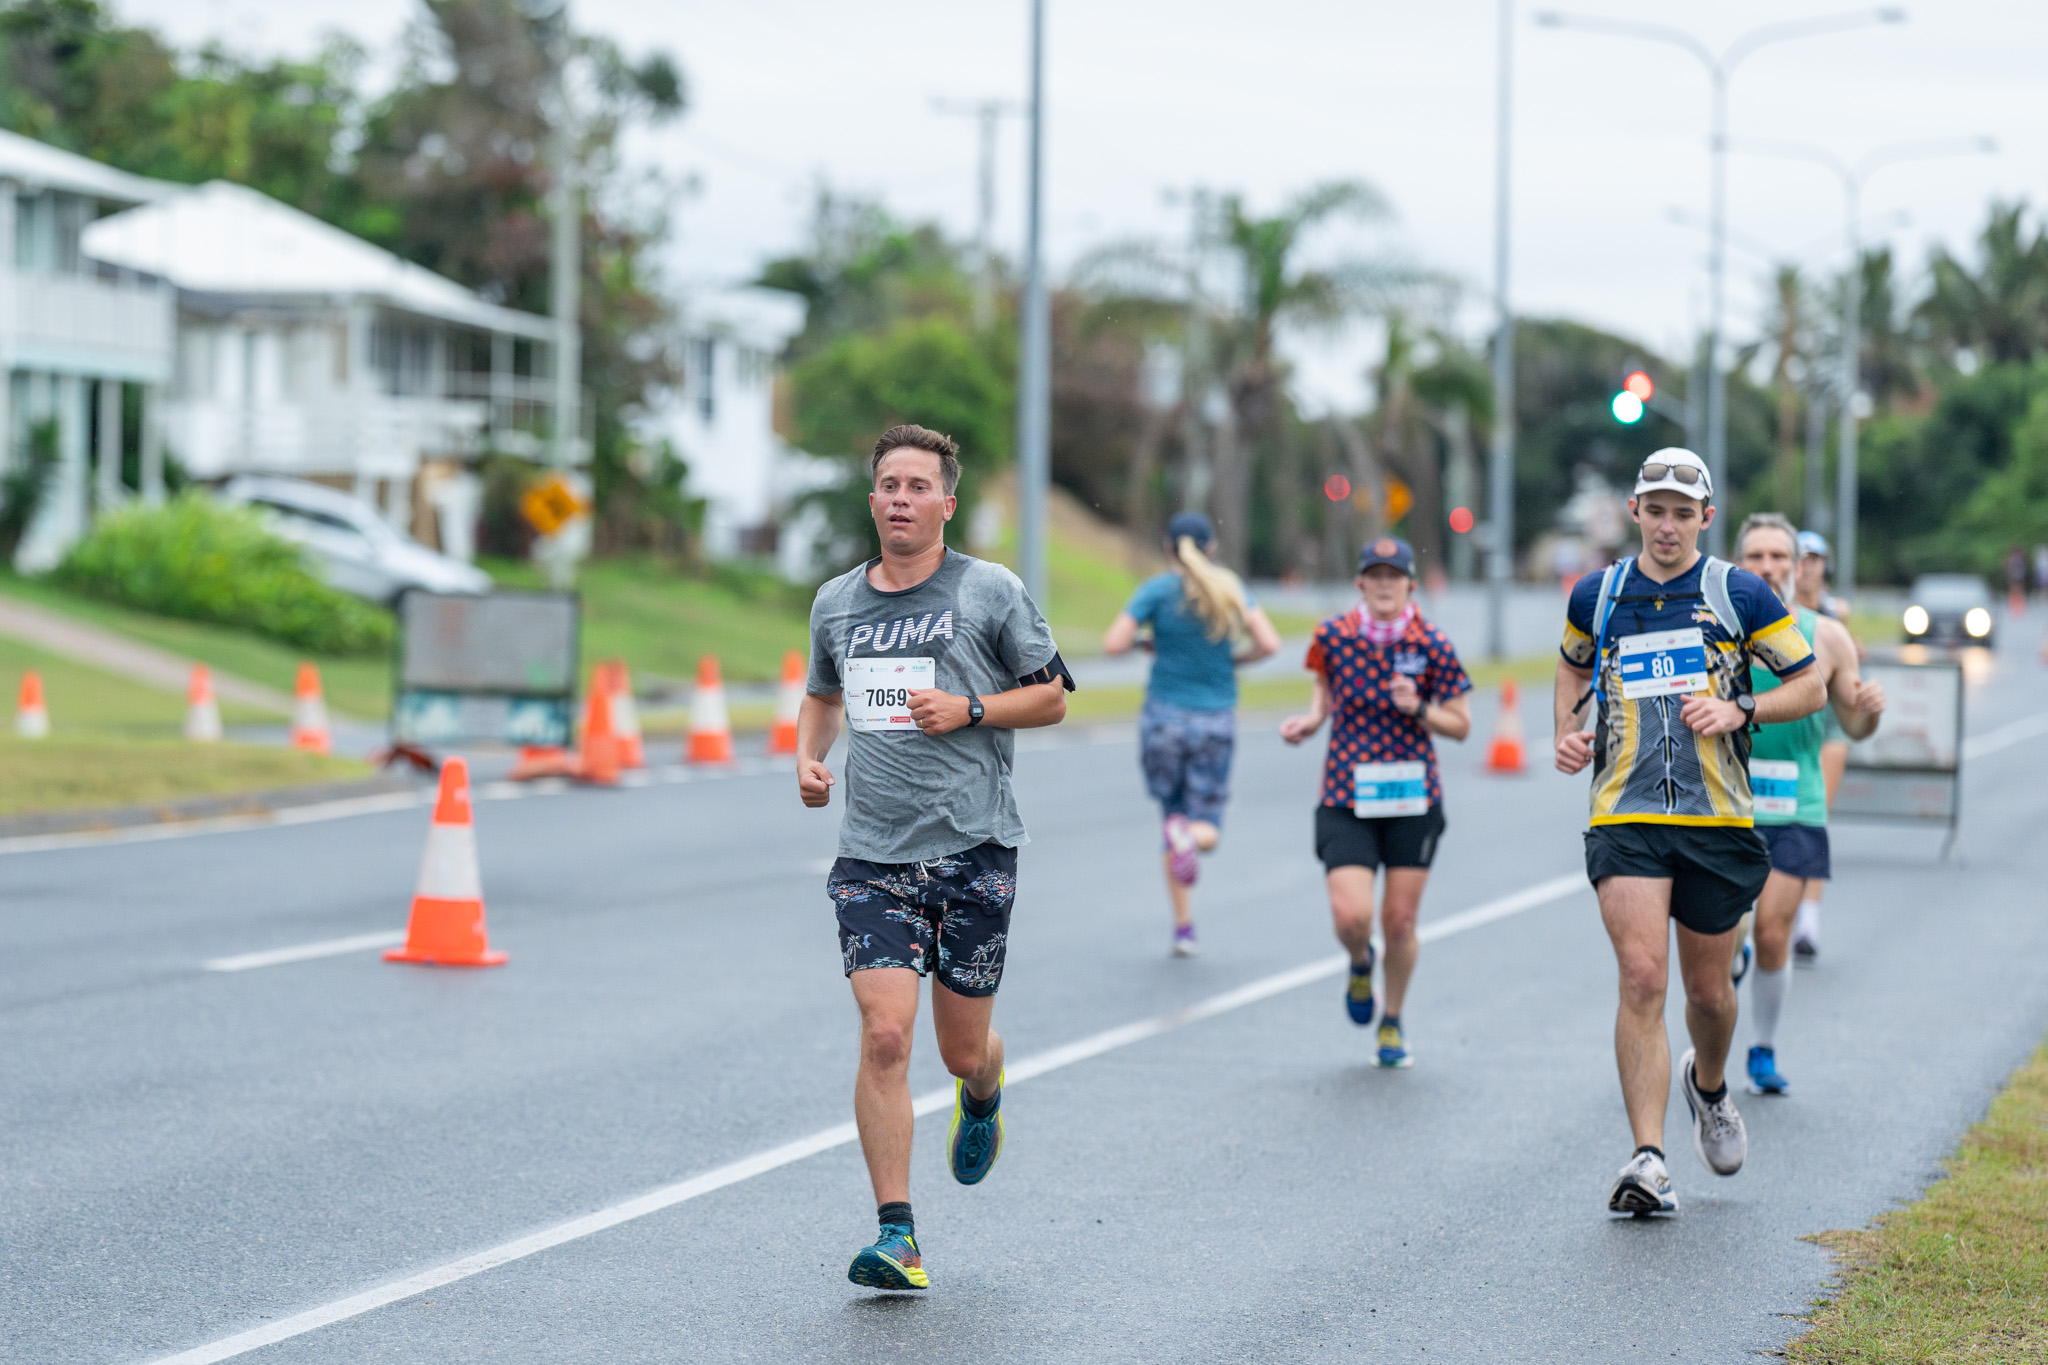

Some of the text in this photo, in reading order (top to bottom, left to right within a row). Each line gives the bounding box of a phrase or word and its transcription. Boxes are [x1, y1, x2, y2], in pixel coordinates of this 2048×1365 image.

[847, 610, 954, 658] PUMA
[1651, 656, 1675, 679] 80
[865, 688, 907, 707] 7059
